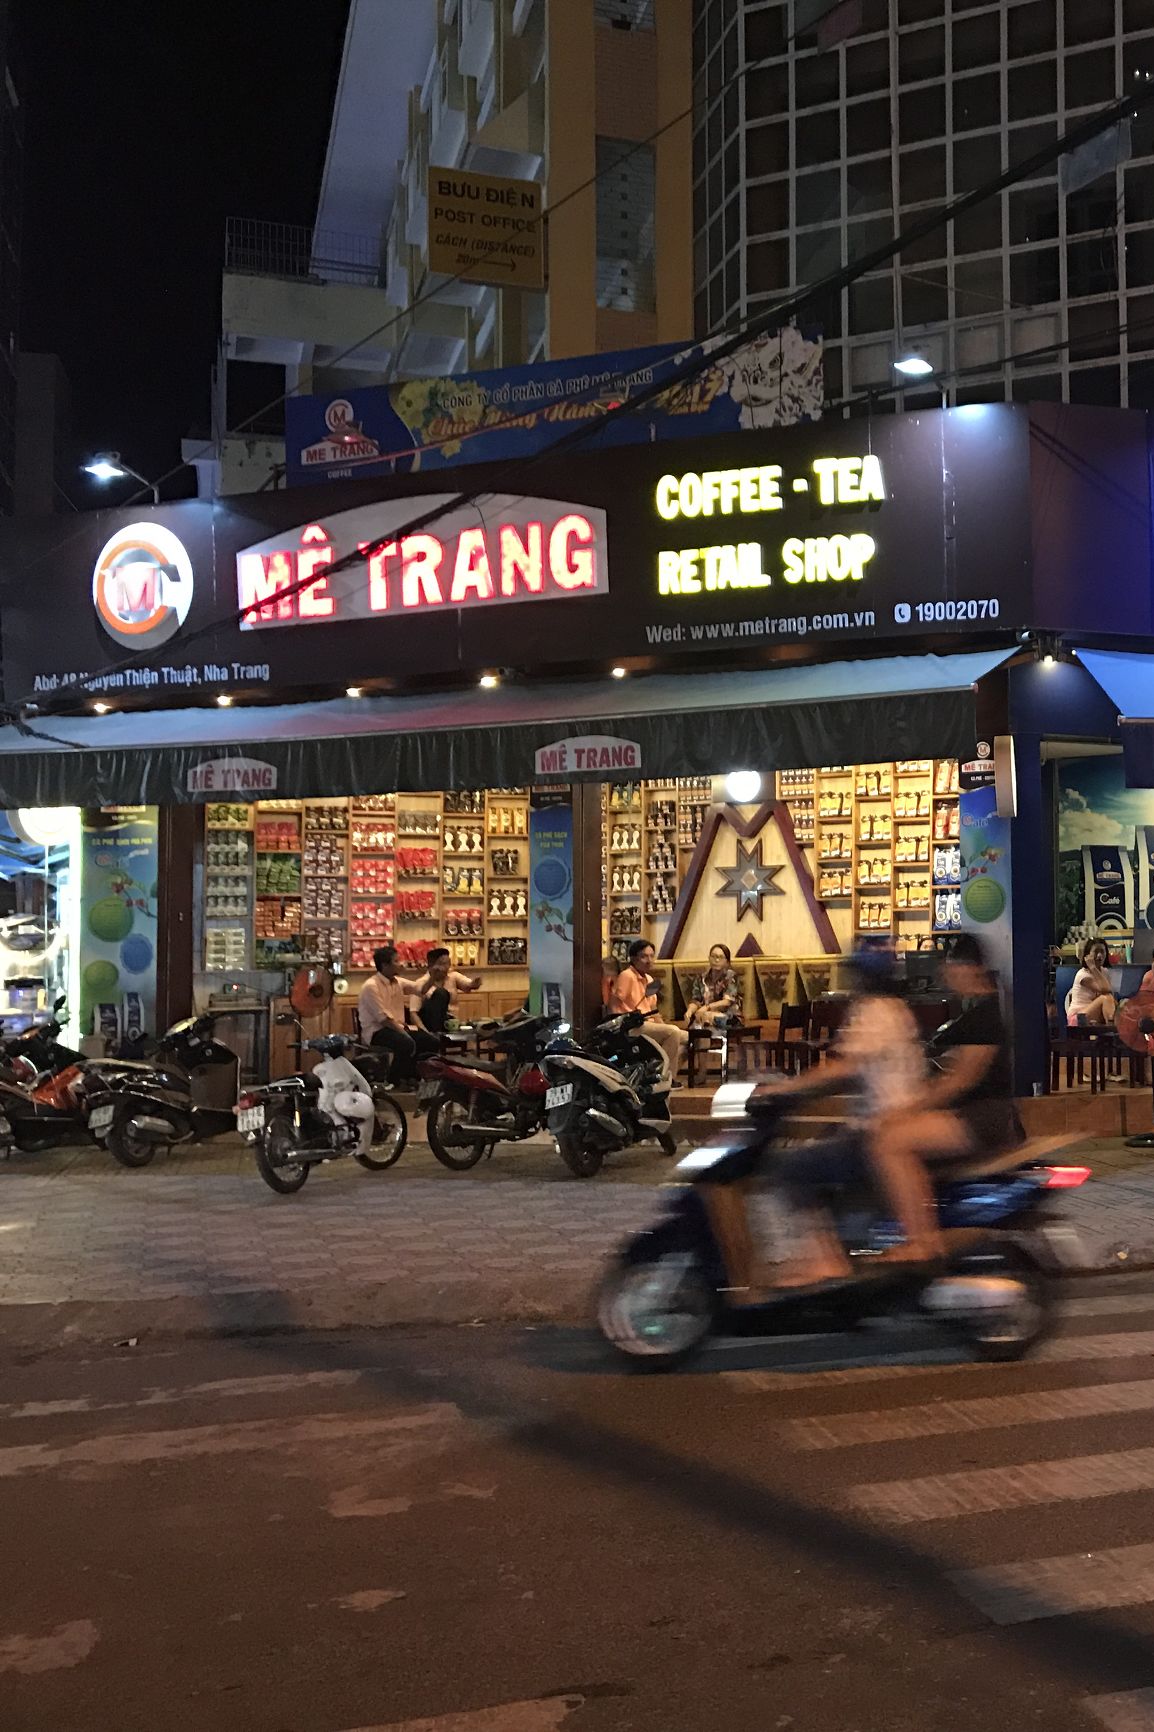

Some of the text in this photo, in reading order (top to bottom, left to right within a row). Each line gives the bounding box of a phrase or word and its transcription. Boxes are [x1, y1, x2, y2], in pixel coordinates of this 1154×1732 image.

[438, 181, 535, 209] BƯU ĐIỆN
[434, 207, 537, 234] POST OFFICE
[656, 465, 783, 520] COFFEE
[812, 455, 885, 506] TEA
[239, 513, 598, 625] MÊ TRANG
[658, 533, 876, 595] RETAIL SHOP
[915, 598, 999, 622] 19002070
[646, 609, 875, 644] Wed: www.metrang.com.vn
[204, 664, 228, 682] Nha
[231, 662, 270, 681] Trang
[540, 743, 636, 772] MÊ TRANG
